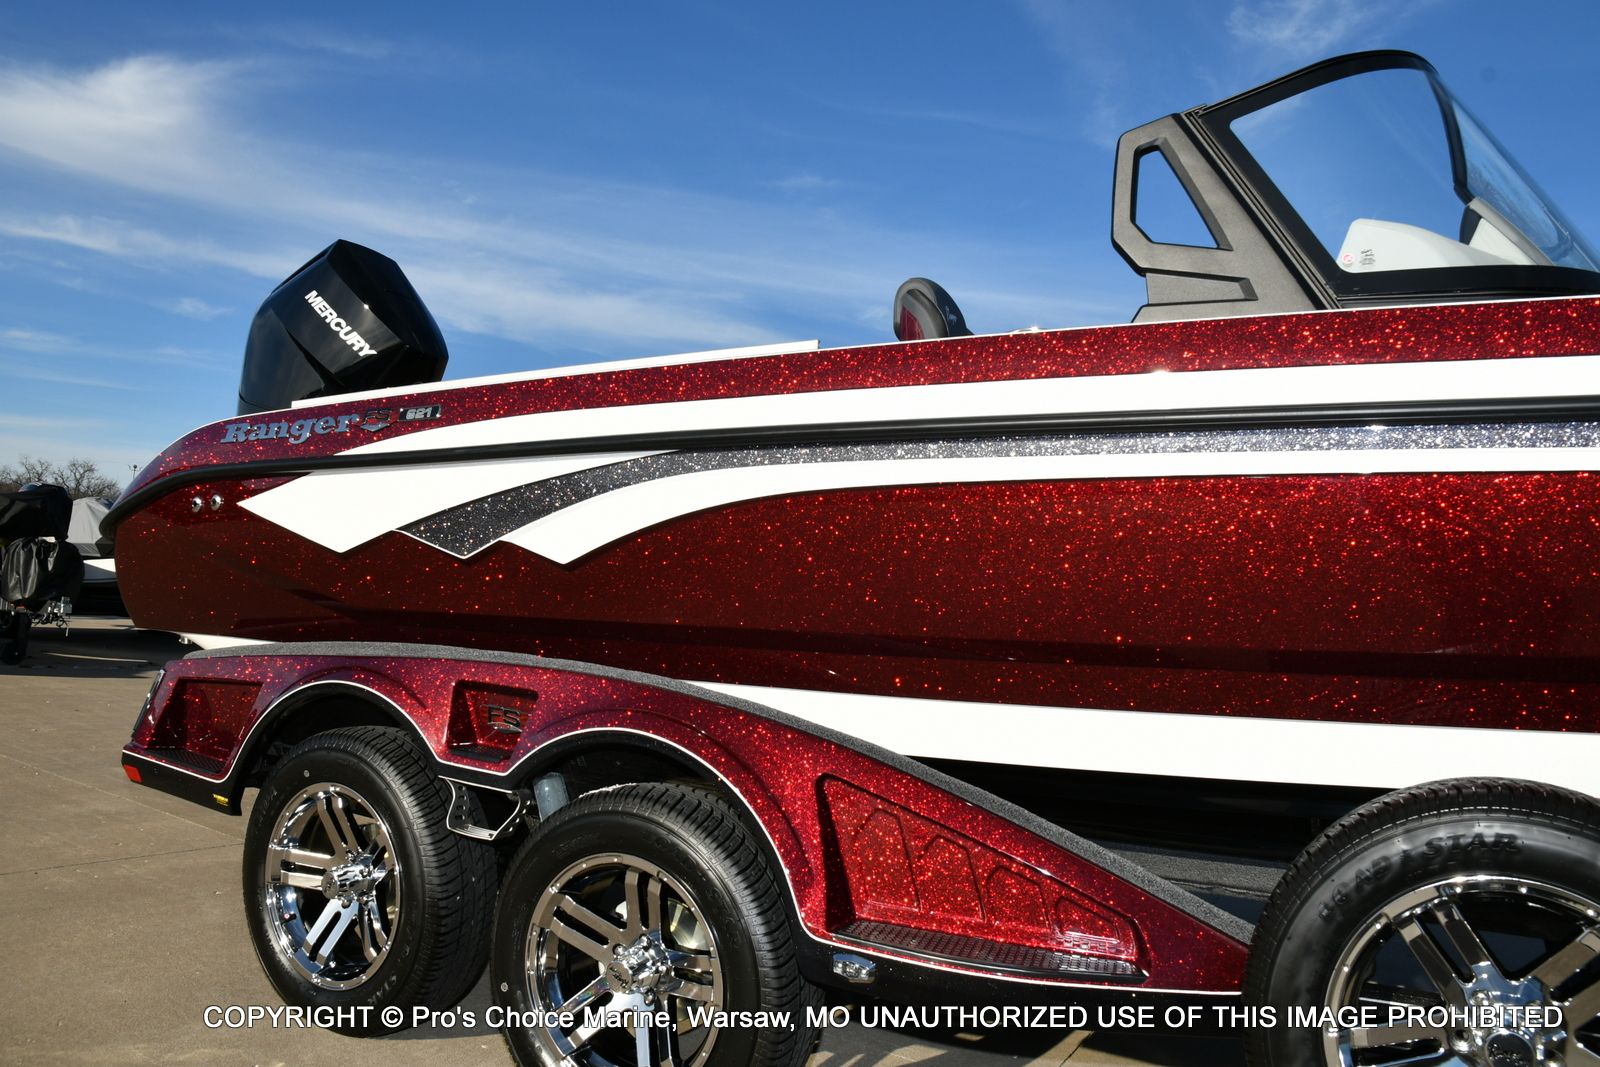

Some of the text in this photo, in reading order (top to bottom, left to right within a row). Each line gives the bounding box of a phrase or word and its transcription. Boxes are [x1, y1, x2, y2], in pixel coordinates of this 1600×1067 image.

[304, 289, 377, 357] MERCURY
[220, 411, 360, 444] Ranger
[405, 406, 434, 420] 621
[1423, 832, 1523, 854] STAR
